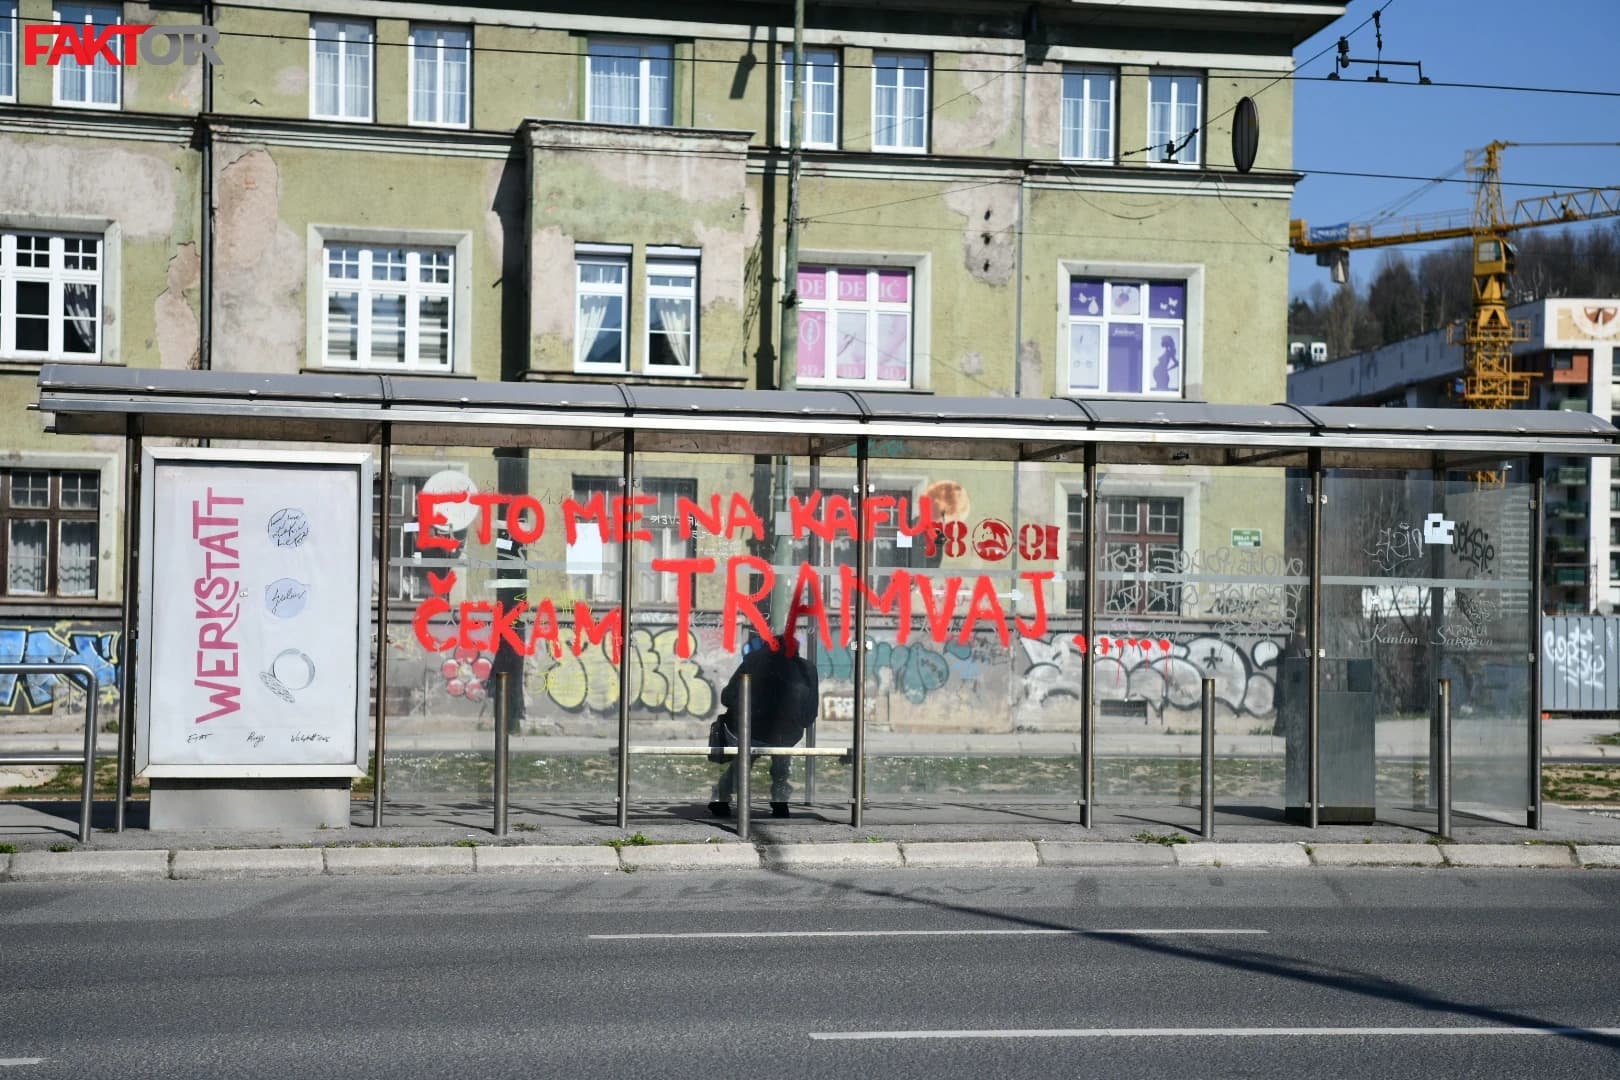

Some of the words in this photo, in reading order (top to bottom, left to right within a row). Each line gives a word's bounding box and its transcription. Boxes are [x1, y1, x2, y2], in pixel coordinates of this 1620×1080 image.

[562, 491, 657, 545] ME
[678, 493, 764, 540] NA
[790, 490, 936, 541] KAFU
[192, 487, 244, 723] WERKSTATT
[412, 572, 625, 665] ČEKAM
[1360, 623, 1418, 645] Kanton
